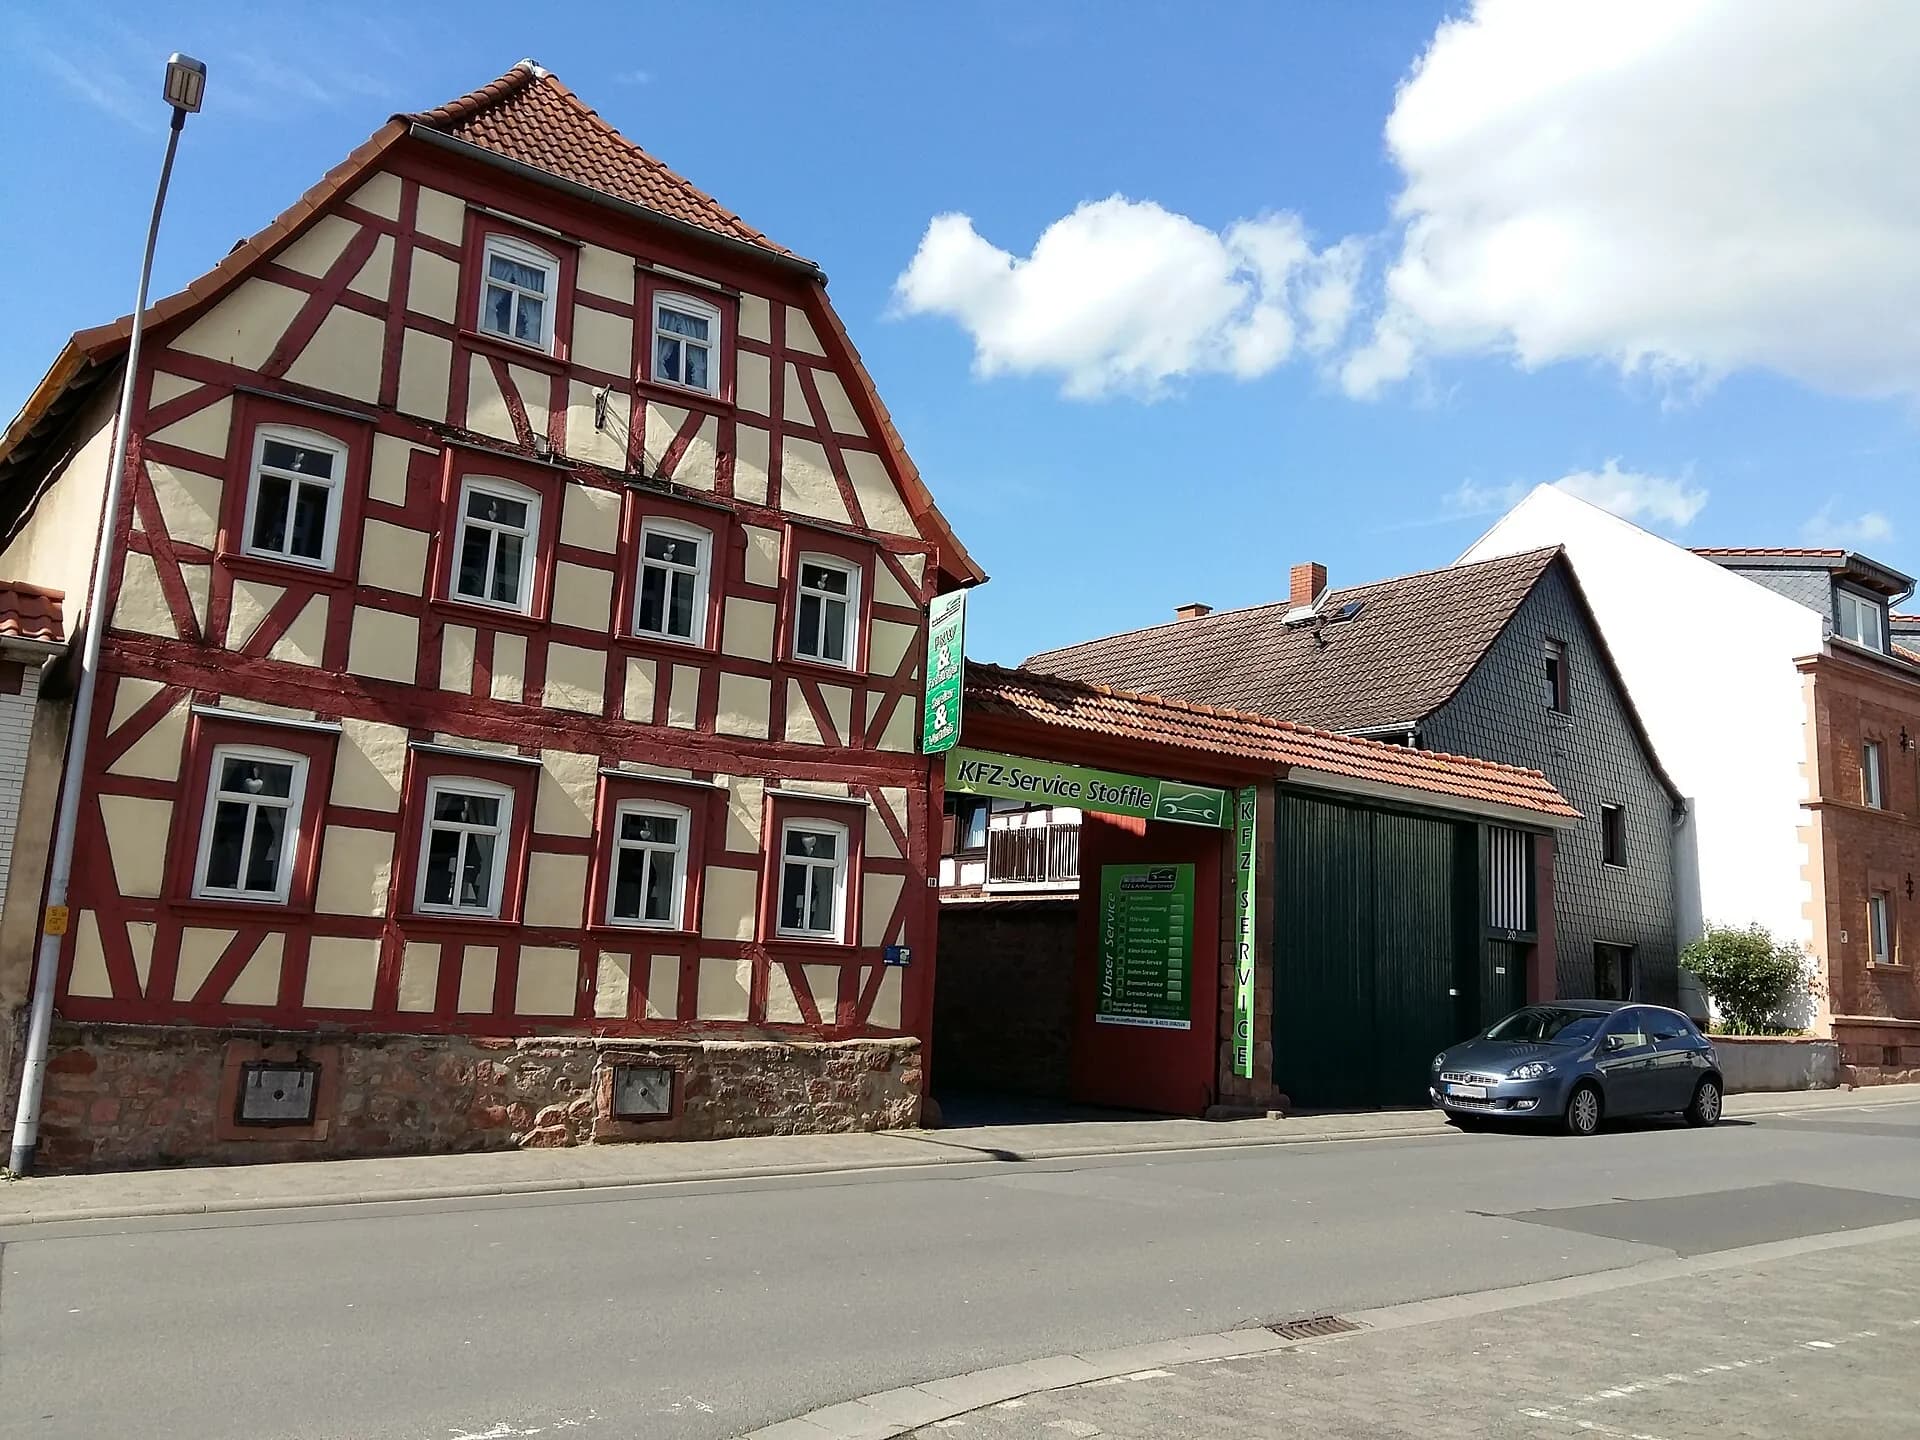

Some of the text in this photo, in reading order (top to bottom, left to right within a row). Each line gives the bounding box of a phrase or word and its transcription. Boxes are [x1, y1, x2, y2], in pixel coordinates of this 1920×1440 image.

[937, 645, 951, 671] &
[934, 703, 948, 730] &
[957, 759, 1153, 810] KFZ-Service Stoffle
[1102, 893, 1116, 997] Unser Service
[1236, 802, 1253, 1067] KFZ SERVICE
[1507, 930, 1517, 940] 20
